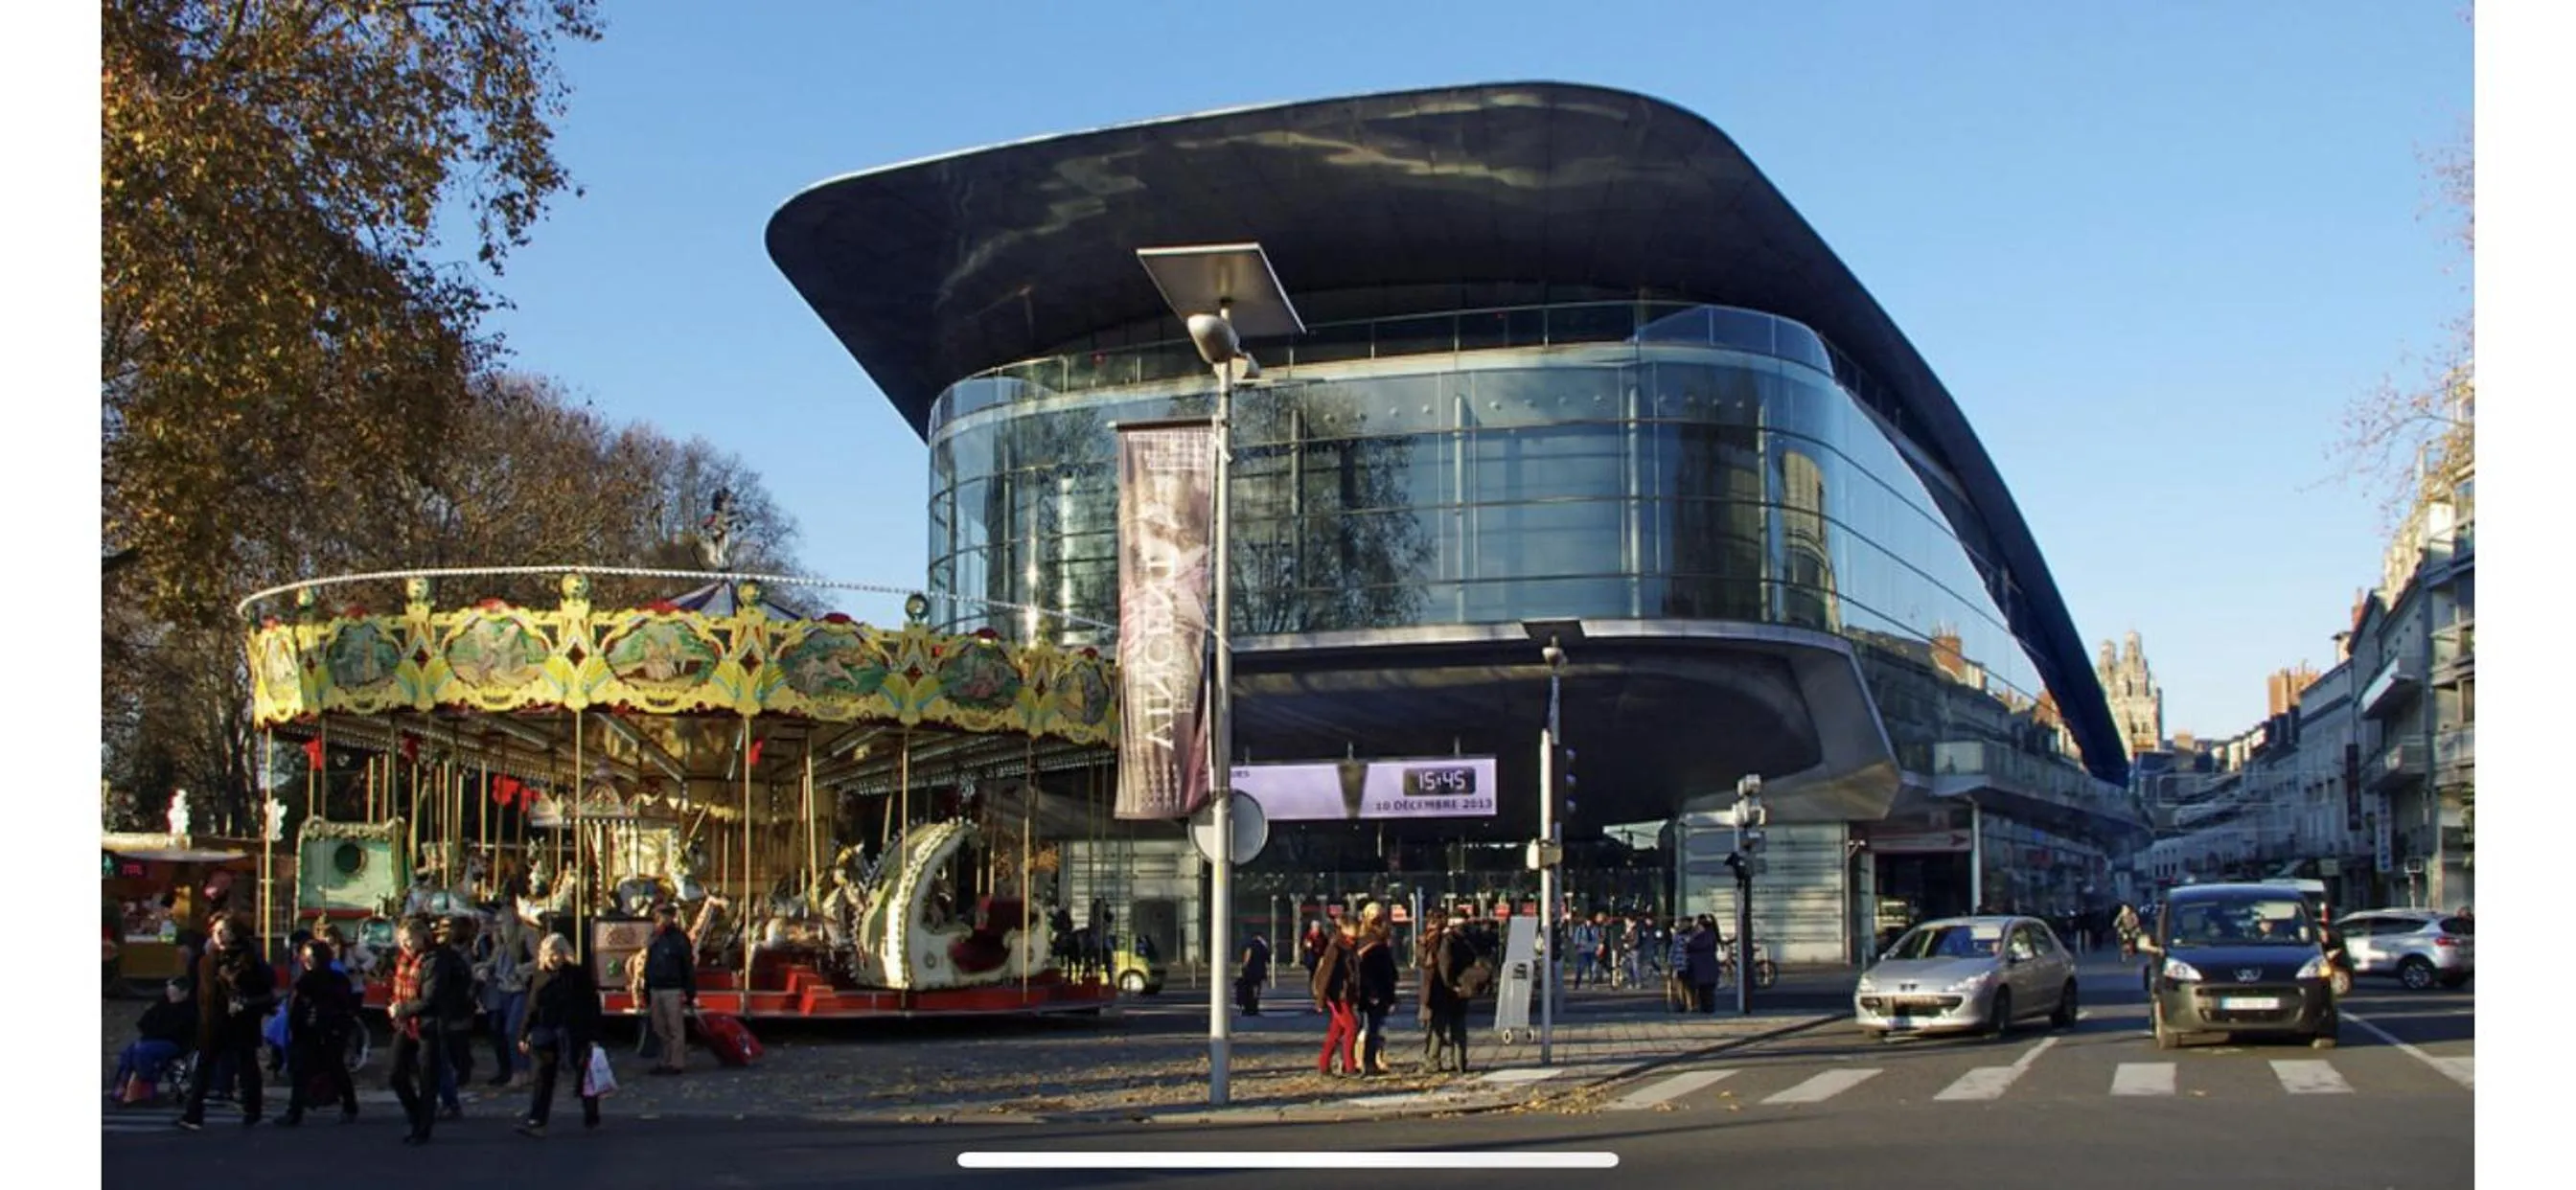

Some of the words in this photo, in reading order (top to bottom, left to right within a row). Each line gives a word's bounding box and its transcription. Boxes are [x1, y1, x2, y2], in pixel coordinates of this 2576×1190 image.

[1418, 770, 1468, 792] 15:45
[1375, 801, 1392, 812] 10
[1462, 798, 1493, 810] 2013
